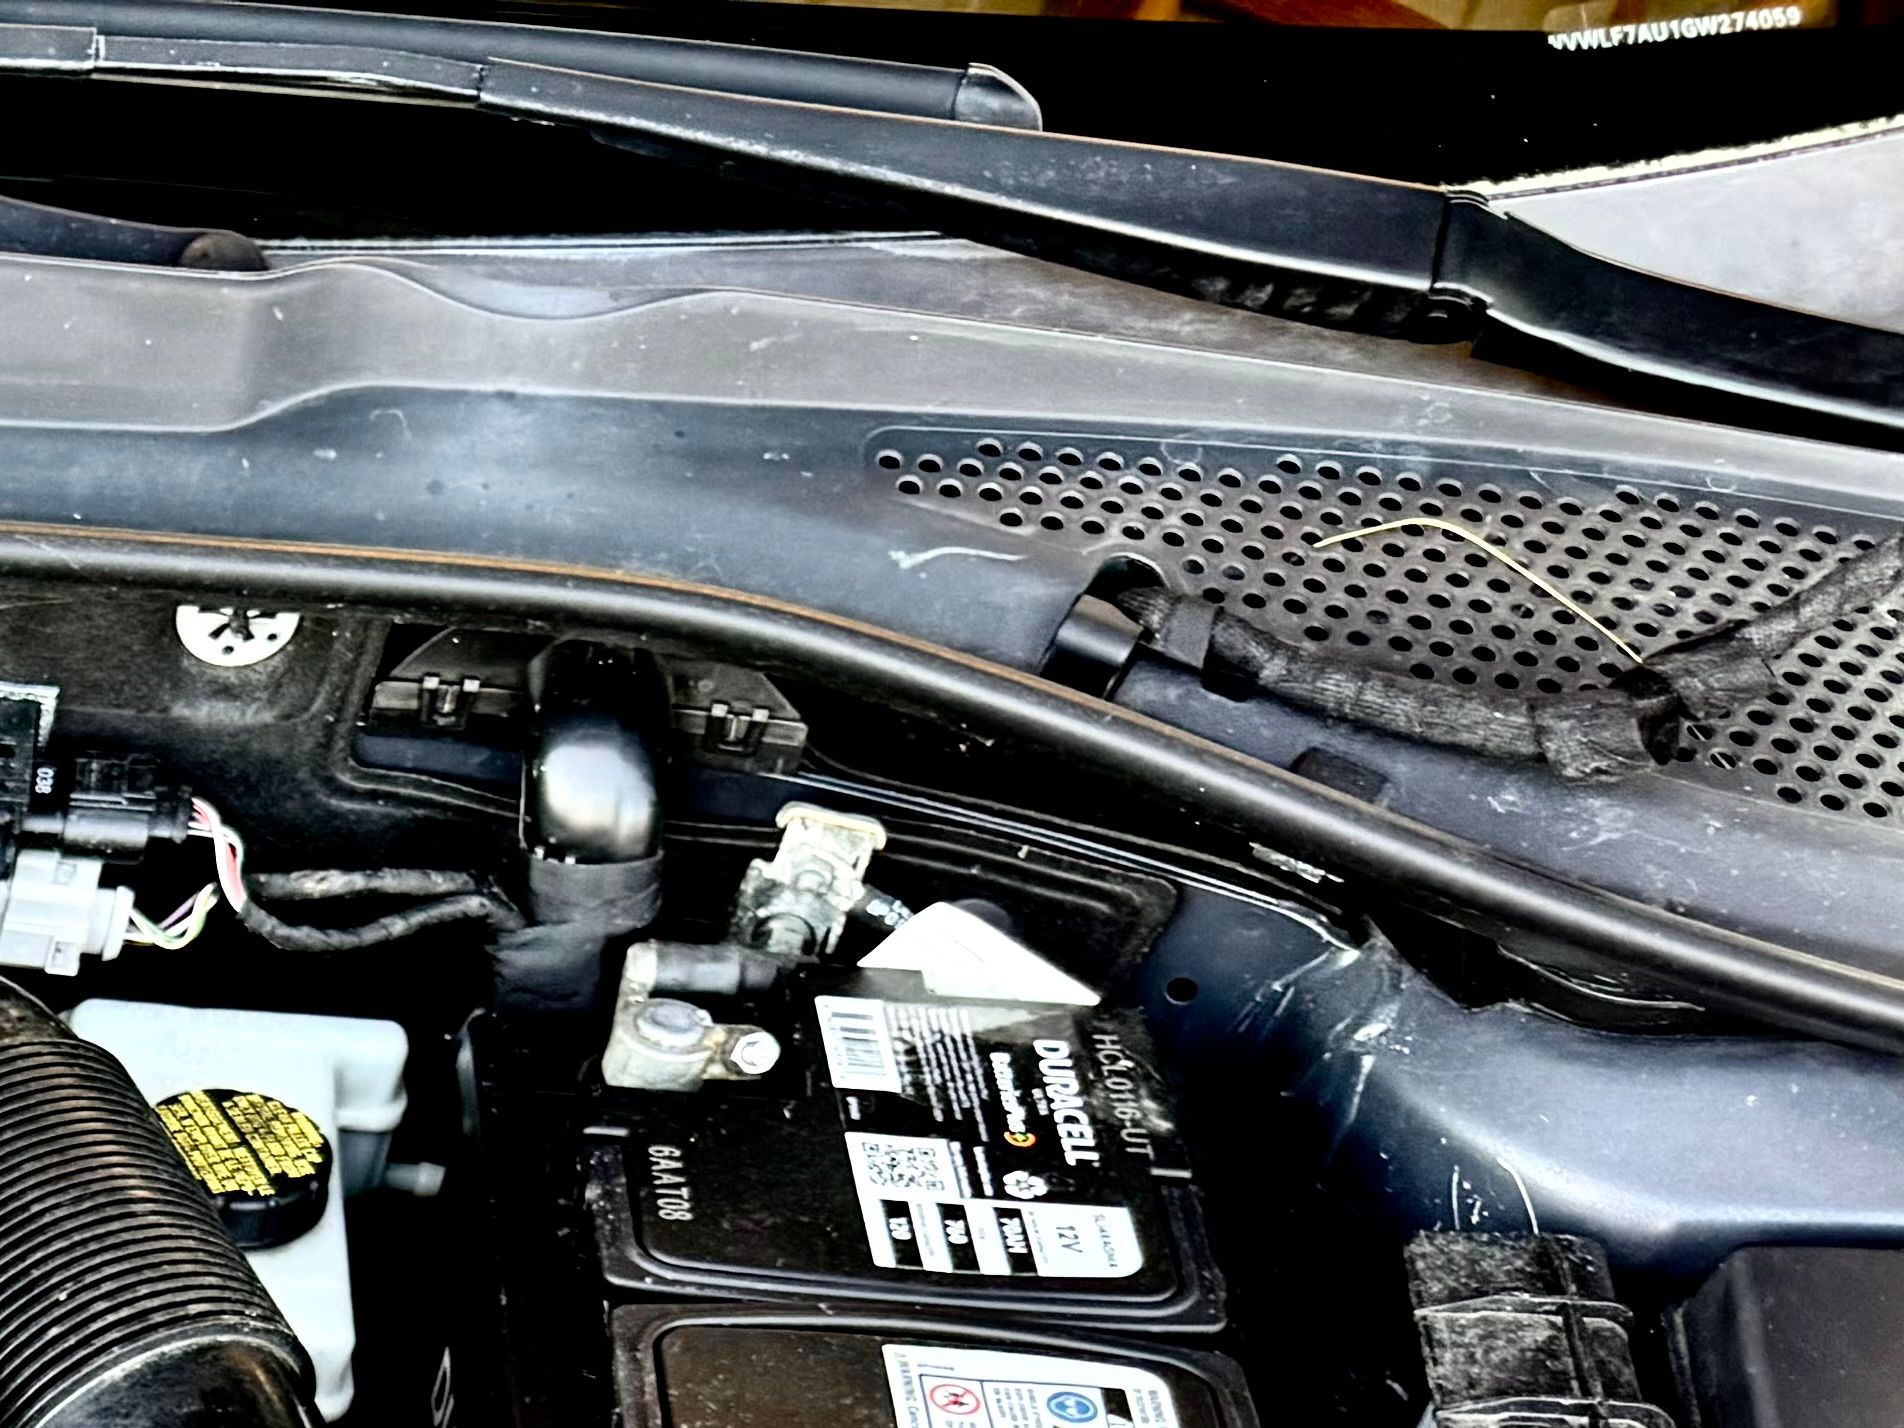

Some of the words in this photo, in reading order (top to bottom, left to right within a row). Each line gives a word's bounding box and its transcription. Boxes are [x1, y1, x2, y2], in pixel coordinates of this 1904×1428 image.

[1033, 1039, 1098, 1167] DURACELL
[647, 1144, 692, 1221] 6AAT08
[1056, 1225, 1083, 1253] 12V
